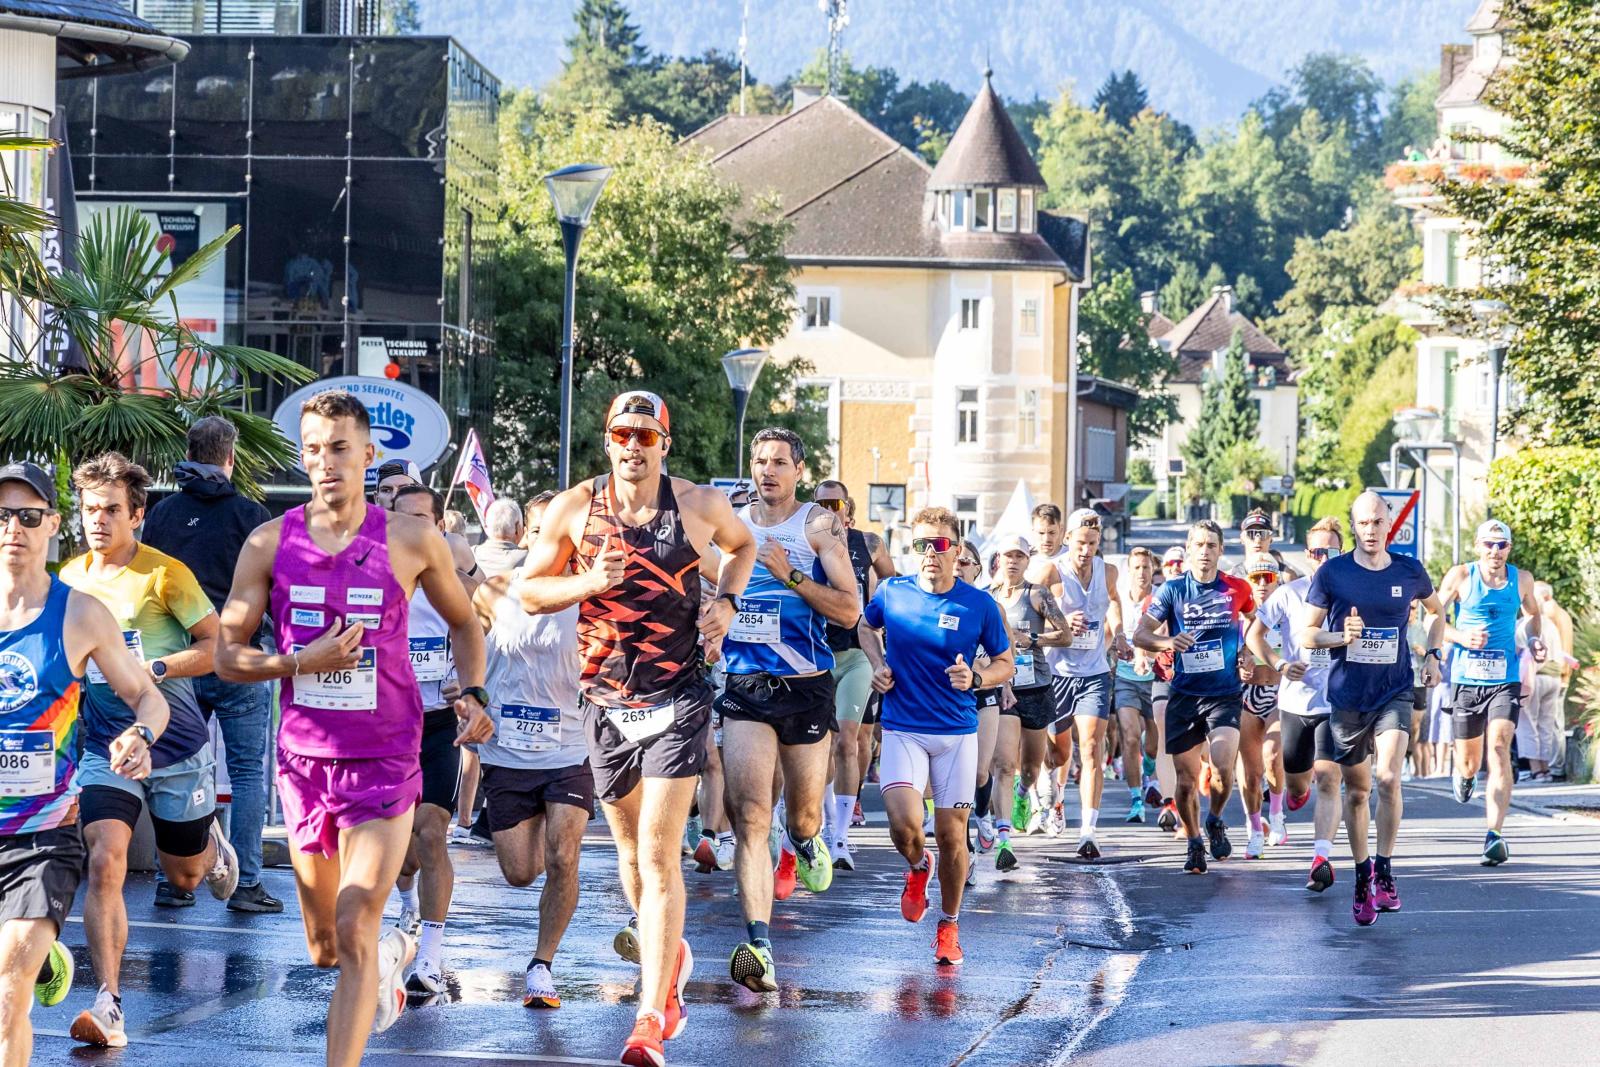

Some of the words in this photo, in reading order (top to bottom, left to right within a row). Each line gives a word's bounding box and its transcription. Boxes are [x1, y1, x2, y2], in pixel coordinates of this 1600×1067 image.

[386, 340, 428, 348] TSCHEBULL
[389, 349, 428, 357] EXKLUSIV
[362, 384, 405, 401] SEEHOTEL
[368, 401, 416, 438] stler
[1397, 528, 1411, 542] 30
[739, 613, 764, 625] 2654
[1361, 640, 1385, 649] 2967
[410, 652, 430, 663] 704
[1195, 652, 1209, 660] 484
[314, 670, 352, 685] 1206
[621, 709, 653, 723] 2631
[516, 720, 543, 733] 2773
[0, 754, 30, 769] 086
